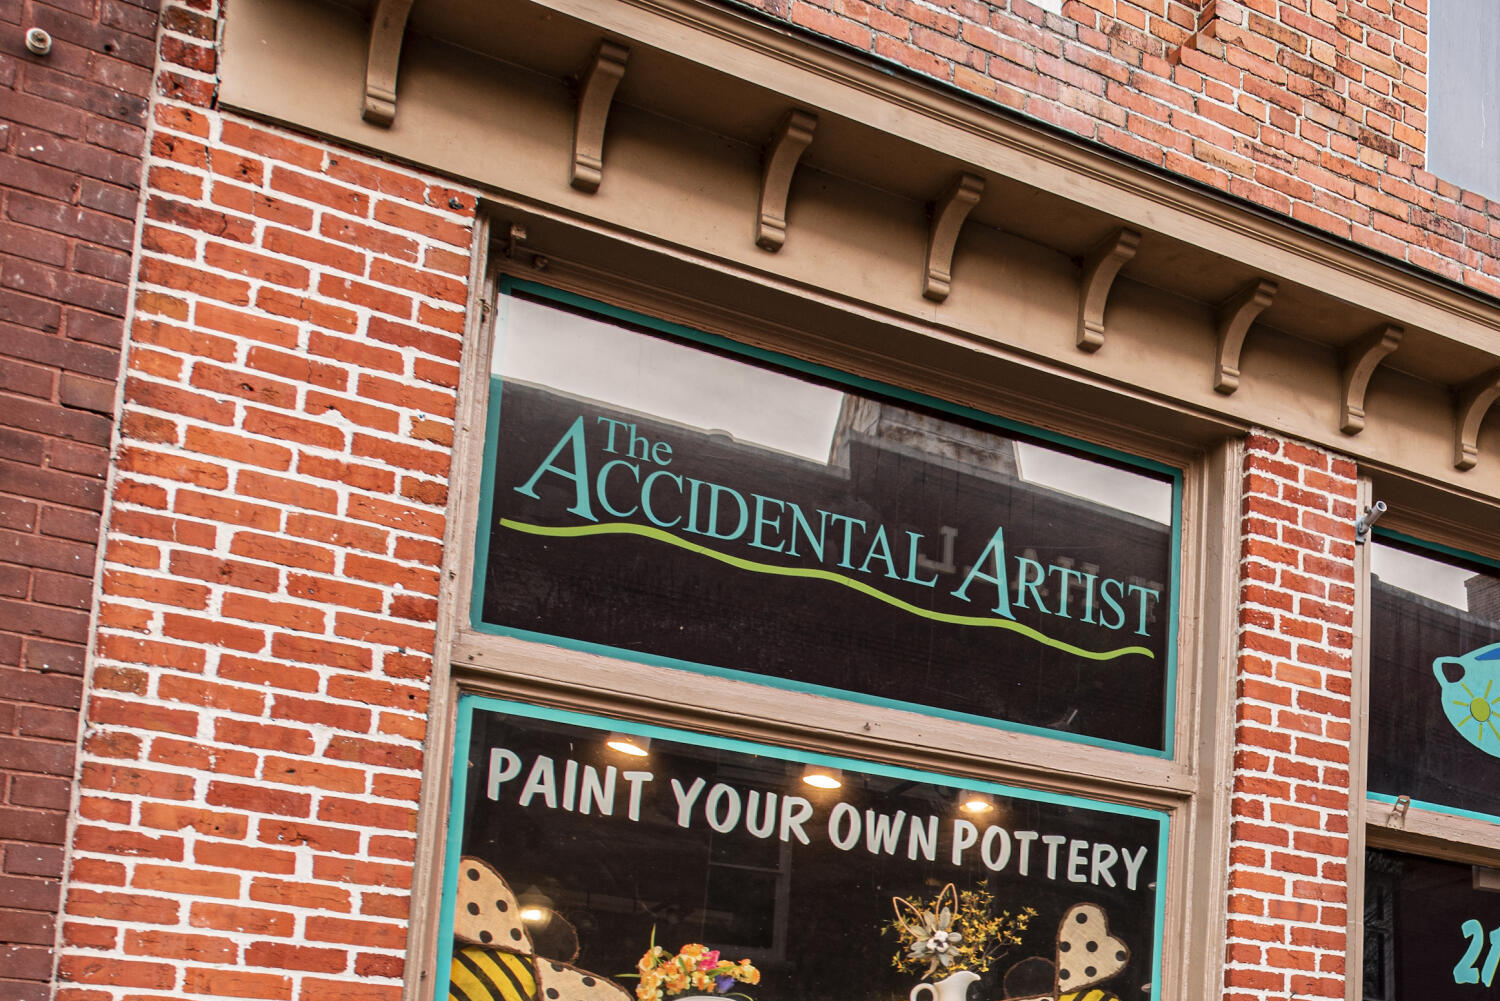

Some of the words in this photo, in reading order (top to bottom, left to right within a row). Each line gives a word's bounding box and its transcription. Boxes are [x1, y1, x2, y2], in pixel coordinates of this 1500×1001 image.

[597, 417, 673, 465] The
[513, 415, 938, 587] ACCIDENTAL
[951, 526, 1160, 637] ARTIST
[487, 747, 653, 822] PAINT
[671, 777, 813, 845] YOUR
[828, 802, 938, 862] OWN
[952, 819, 1148, 891] POTTERY
